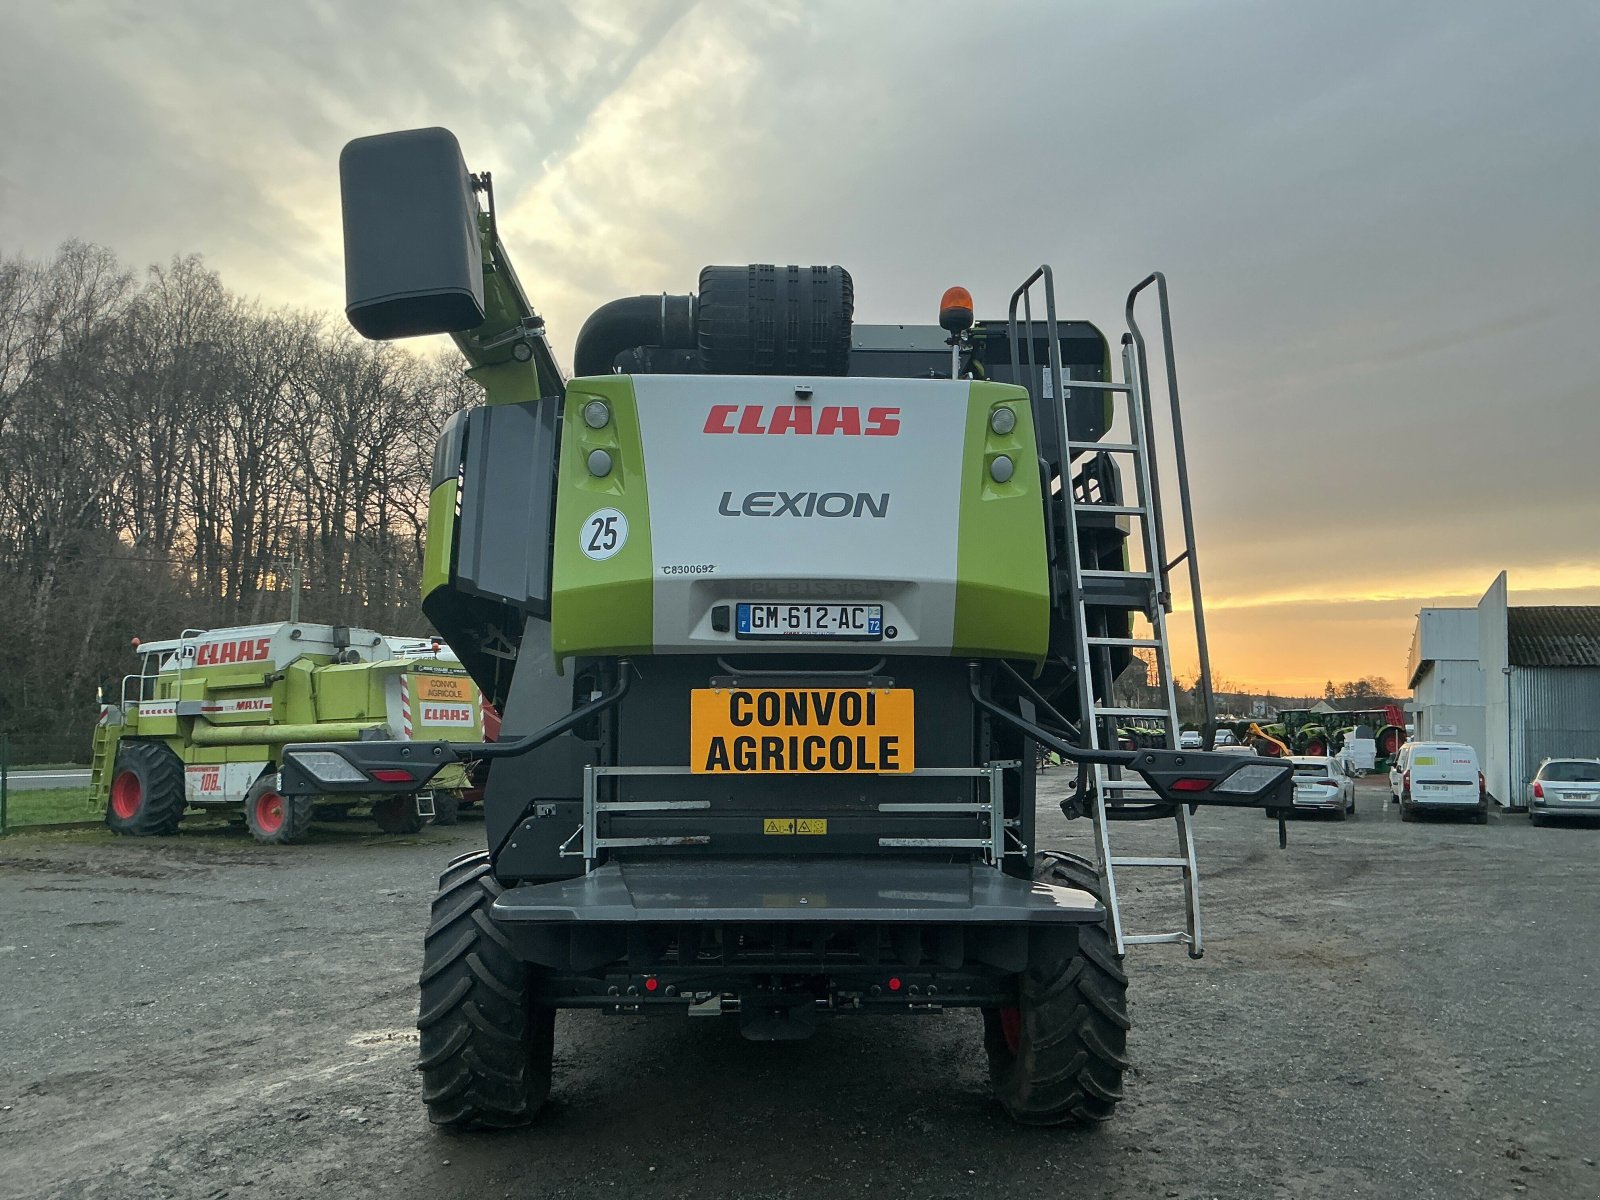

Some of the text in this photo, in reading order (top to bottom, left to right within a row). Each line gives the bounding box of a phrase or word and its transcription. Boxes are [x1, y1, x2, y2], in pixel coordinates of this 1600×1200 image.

[702, 404, 901, 437] CLAAS
[718, 491, 890, 518] LEXION
[588, 516, 618, 551] 25
[662, 564, 716, 575] C8300692
[741, 606, 880, 631] F GM-612-AC 72
[197, 638, 271, 666] CLAAS
[427, 689, 463, 698] AGRICOLE
[430, 679, 457, 688] CONVOI
[236, 699, 264, 711] MAXI
[424, 708, 470, 721] CLAAS
[729, 691, 876, 727] CONVOI
[705, 735, 900, 771] AGRICOLE
